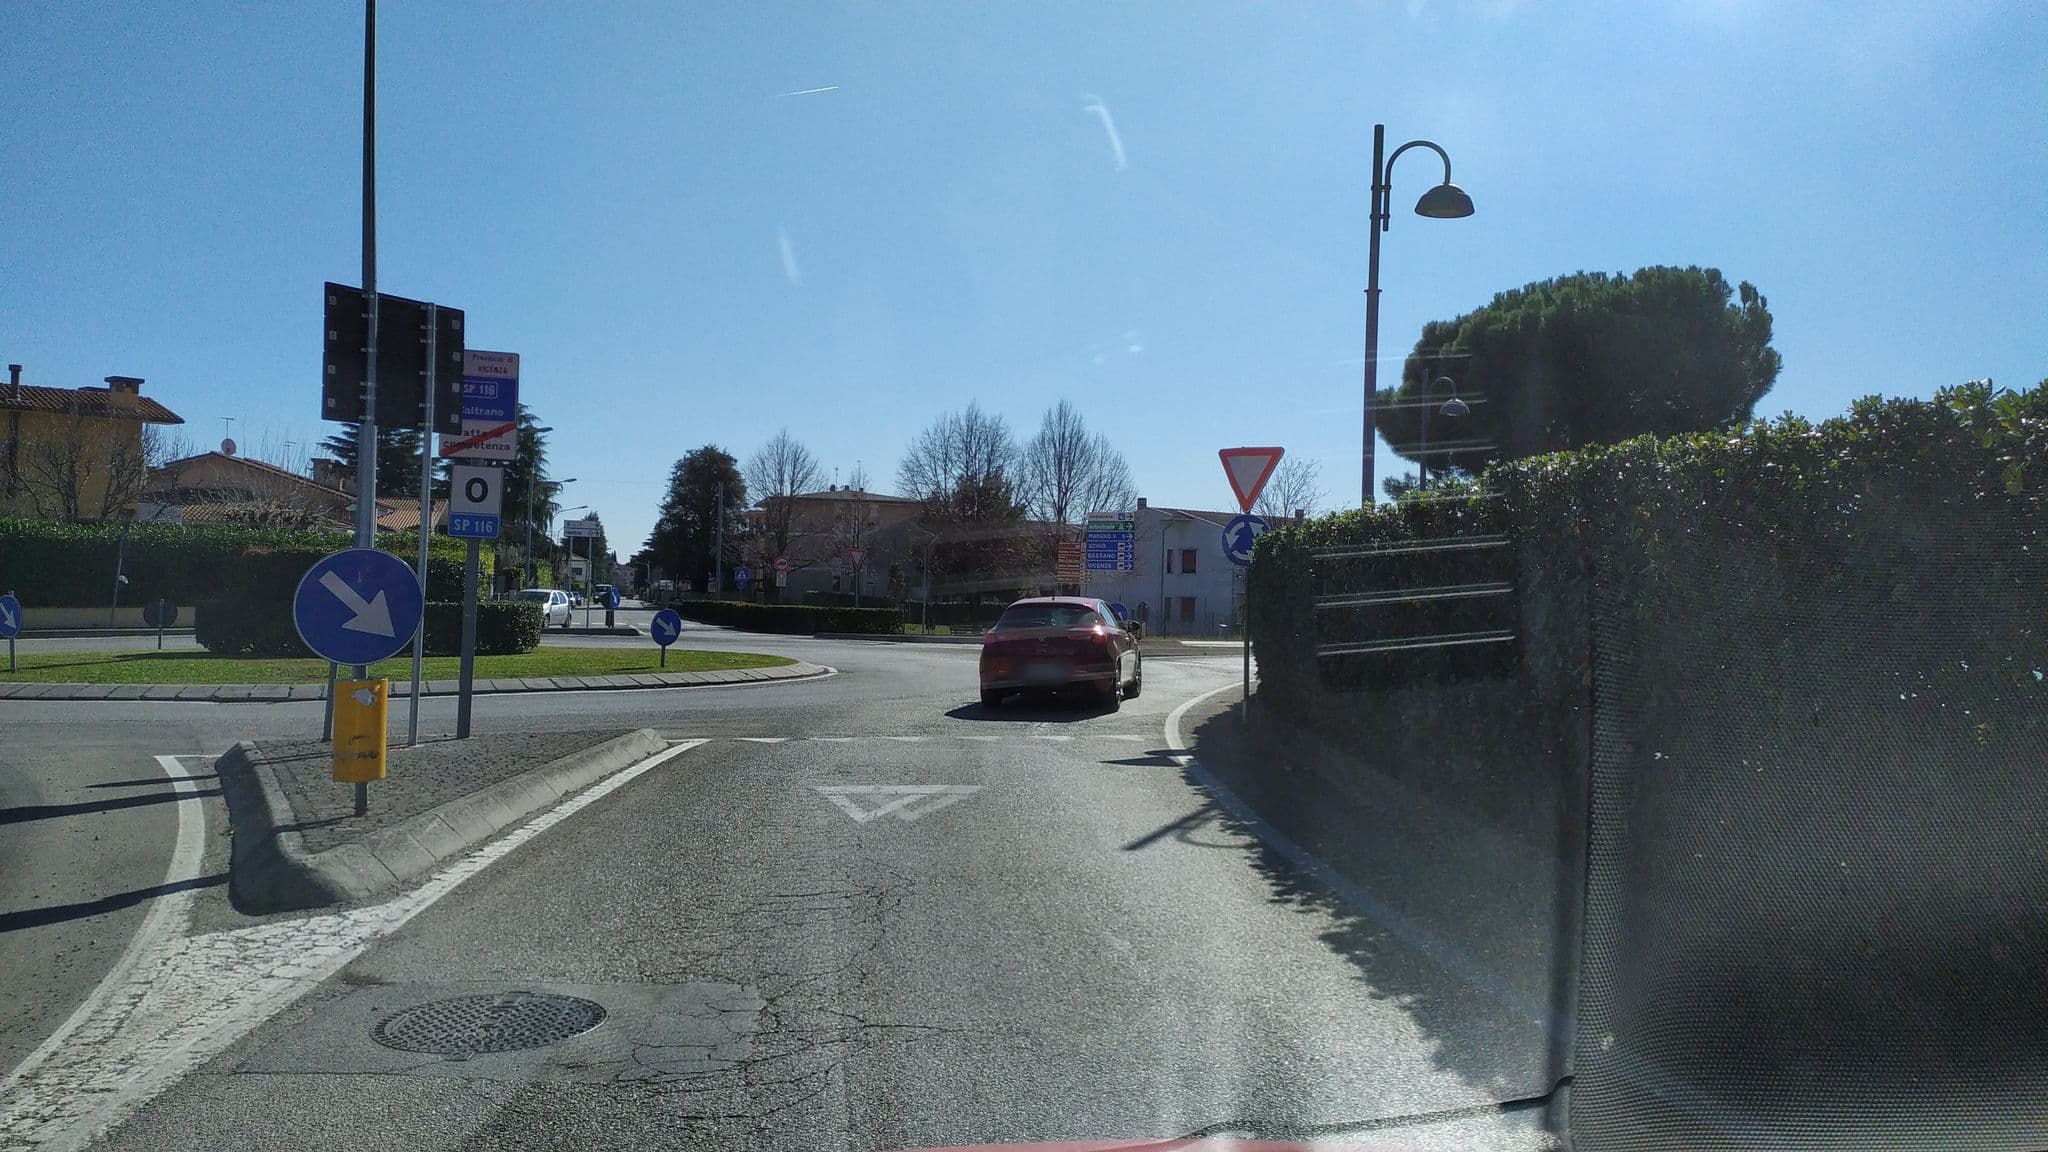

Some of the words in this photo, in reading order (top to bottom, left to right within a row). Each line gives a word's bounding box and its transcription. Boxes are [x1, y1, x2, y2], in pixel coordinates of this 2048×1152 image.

[478, 365, 508, 374] VICENZA
[463, 384, 474, 393] SP
[479, 384, 496, 396] 116
[462, 405, 504, 417] altrano
[454, 518, 470, 532] SP
[474, 520, 493, 533] 116
